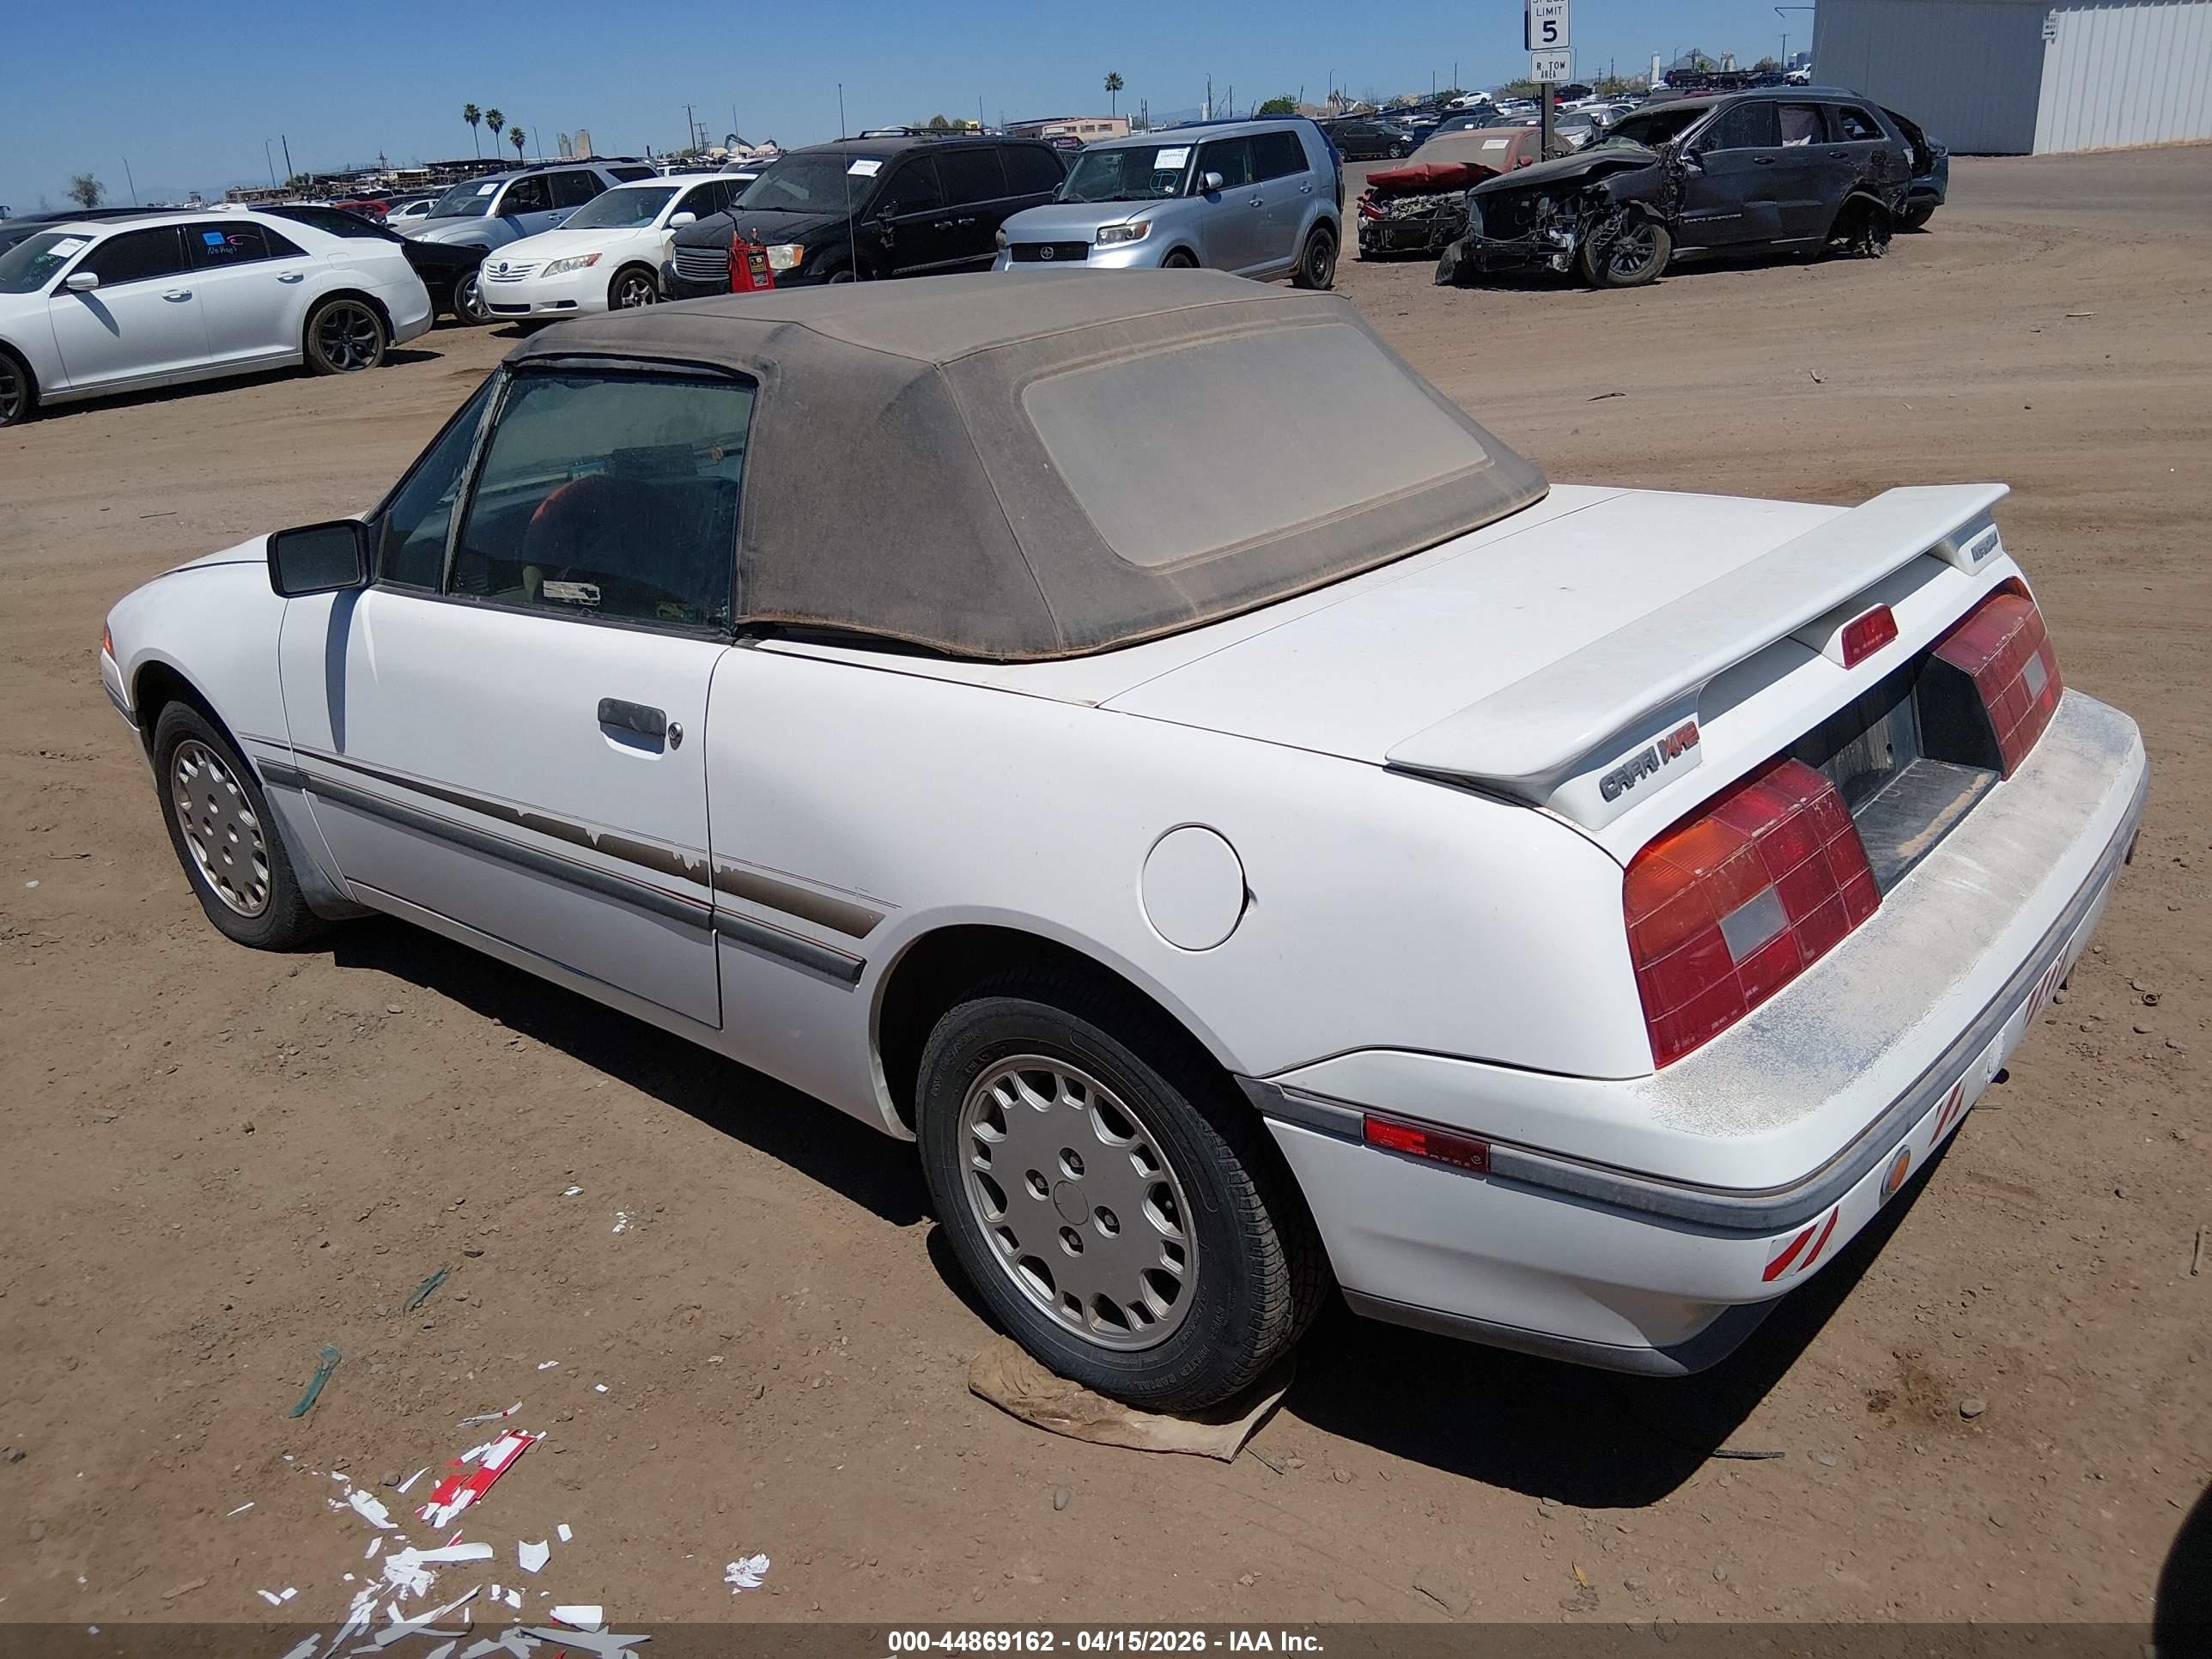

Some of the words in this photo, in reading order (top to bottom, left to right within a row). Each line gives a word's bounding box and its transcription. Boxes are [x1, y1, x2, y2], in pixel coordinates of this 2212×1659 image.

[1536, 6, 1563, 16] LIMIT
[1542, 20, 1558, 43] 5
[1549, 61, 1565, 70] TOW
[1540, 70, 1557, 79] AREA
[1599, 745, 1660, 803] CAPRI
